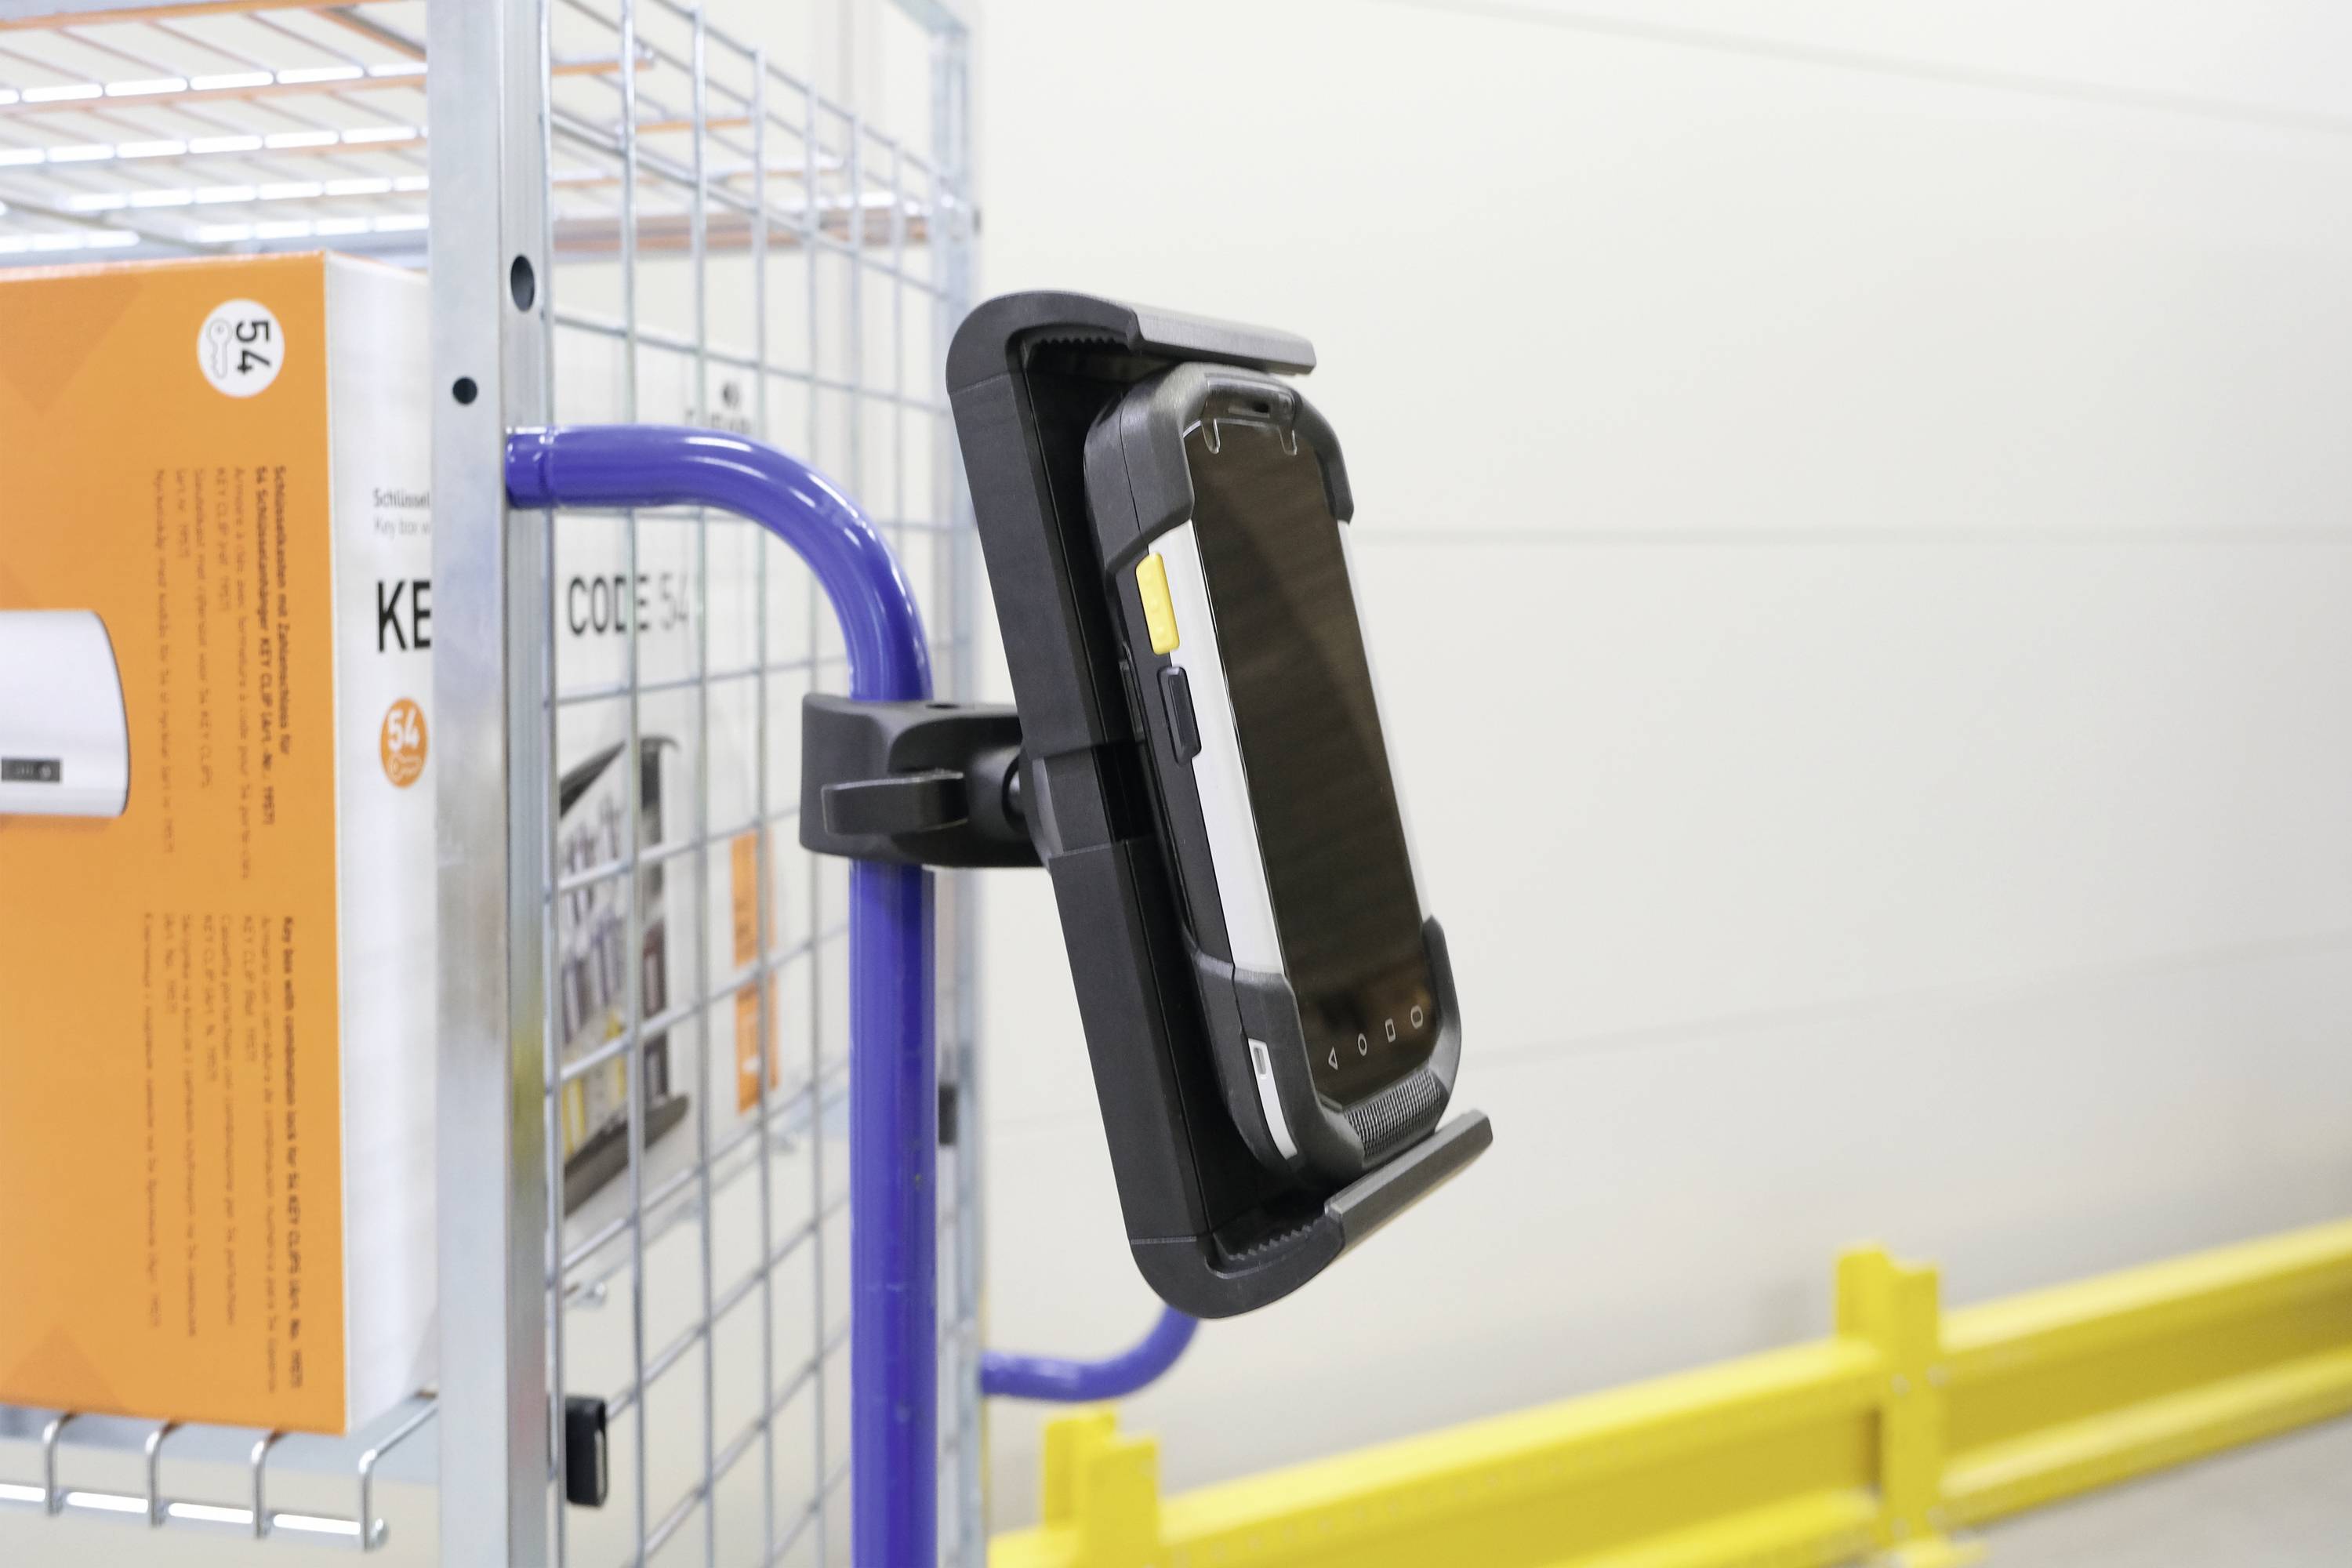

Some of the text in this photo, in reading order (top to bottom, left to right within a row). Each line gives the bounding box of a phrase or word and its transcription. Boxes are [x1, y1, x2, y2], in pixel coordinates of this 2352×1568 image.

[236, 319, 271, 374] 54
[372, 486, 430, 508] Schlüssel
[374, 579, 431, 653] KE
[387, 707, 421, 751] 54
